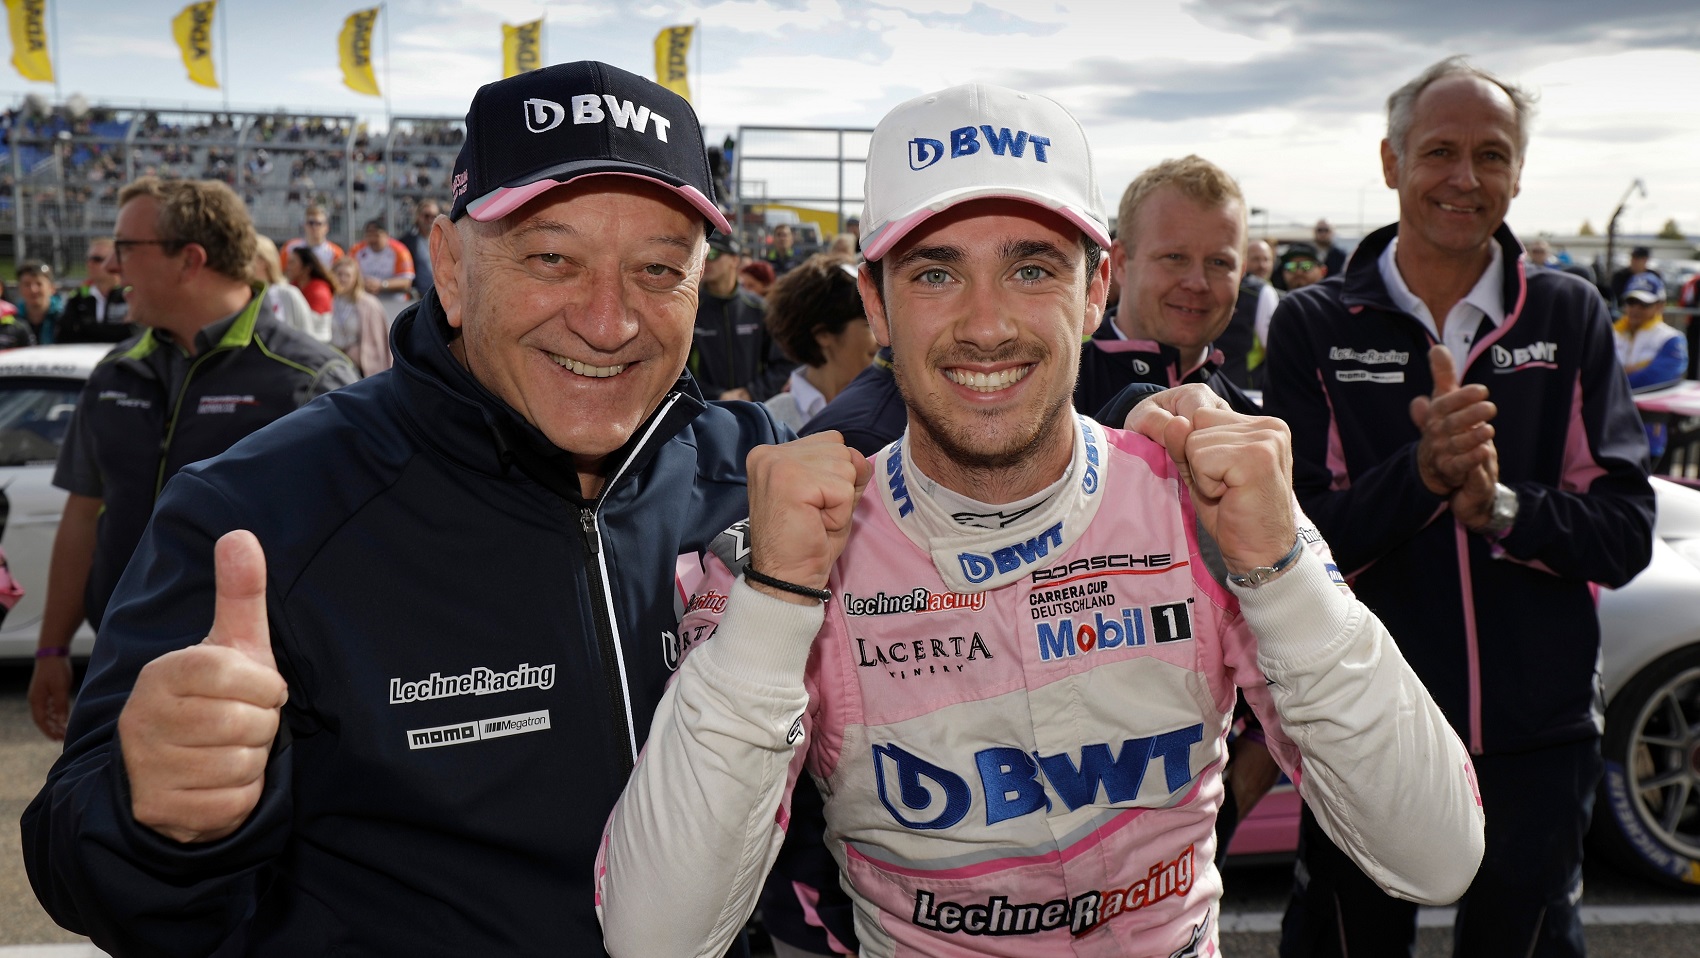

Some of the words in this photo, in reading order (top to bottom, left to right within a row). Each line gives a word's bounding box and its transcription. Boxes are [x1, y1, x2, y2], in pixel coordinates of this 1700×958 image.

[571, 93, 671, 143] BWT
[950, 124, 1051, 163] BWT
[1513, 341, 1557, 366] BWT
[992, 521, 1063, 575] BWT
[1032, 553, 1171, 583] PORSCHE
[1029, 584, 1086, 606] CARRERA
[1087, 580, 1108, 595] CUP
[1031, 594, 1116, 619] DEUTSCHLAND
[1035, 607, 1147, 661] Mobil
[501, 715, 546, 731] Megatron
[974, 722, 1204, 826] BWT
